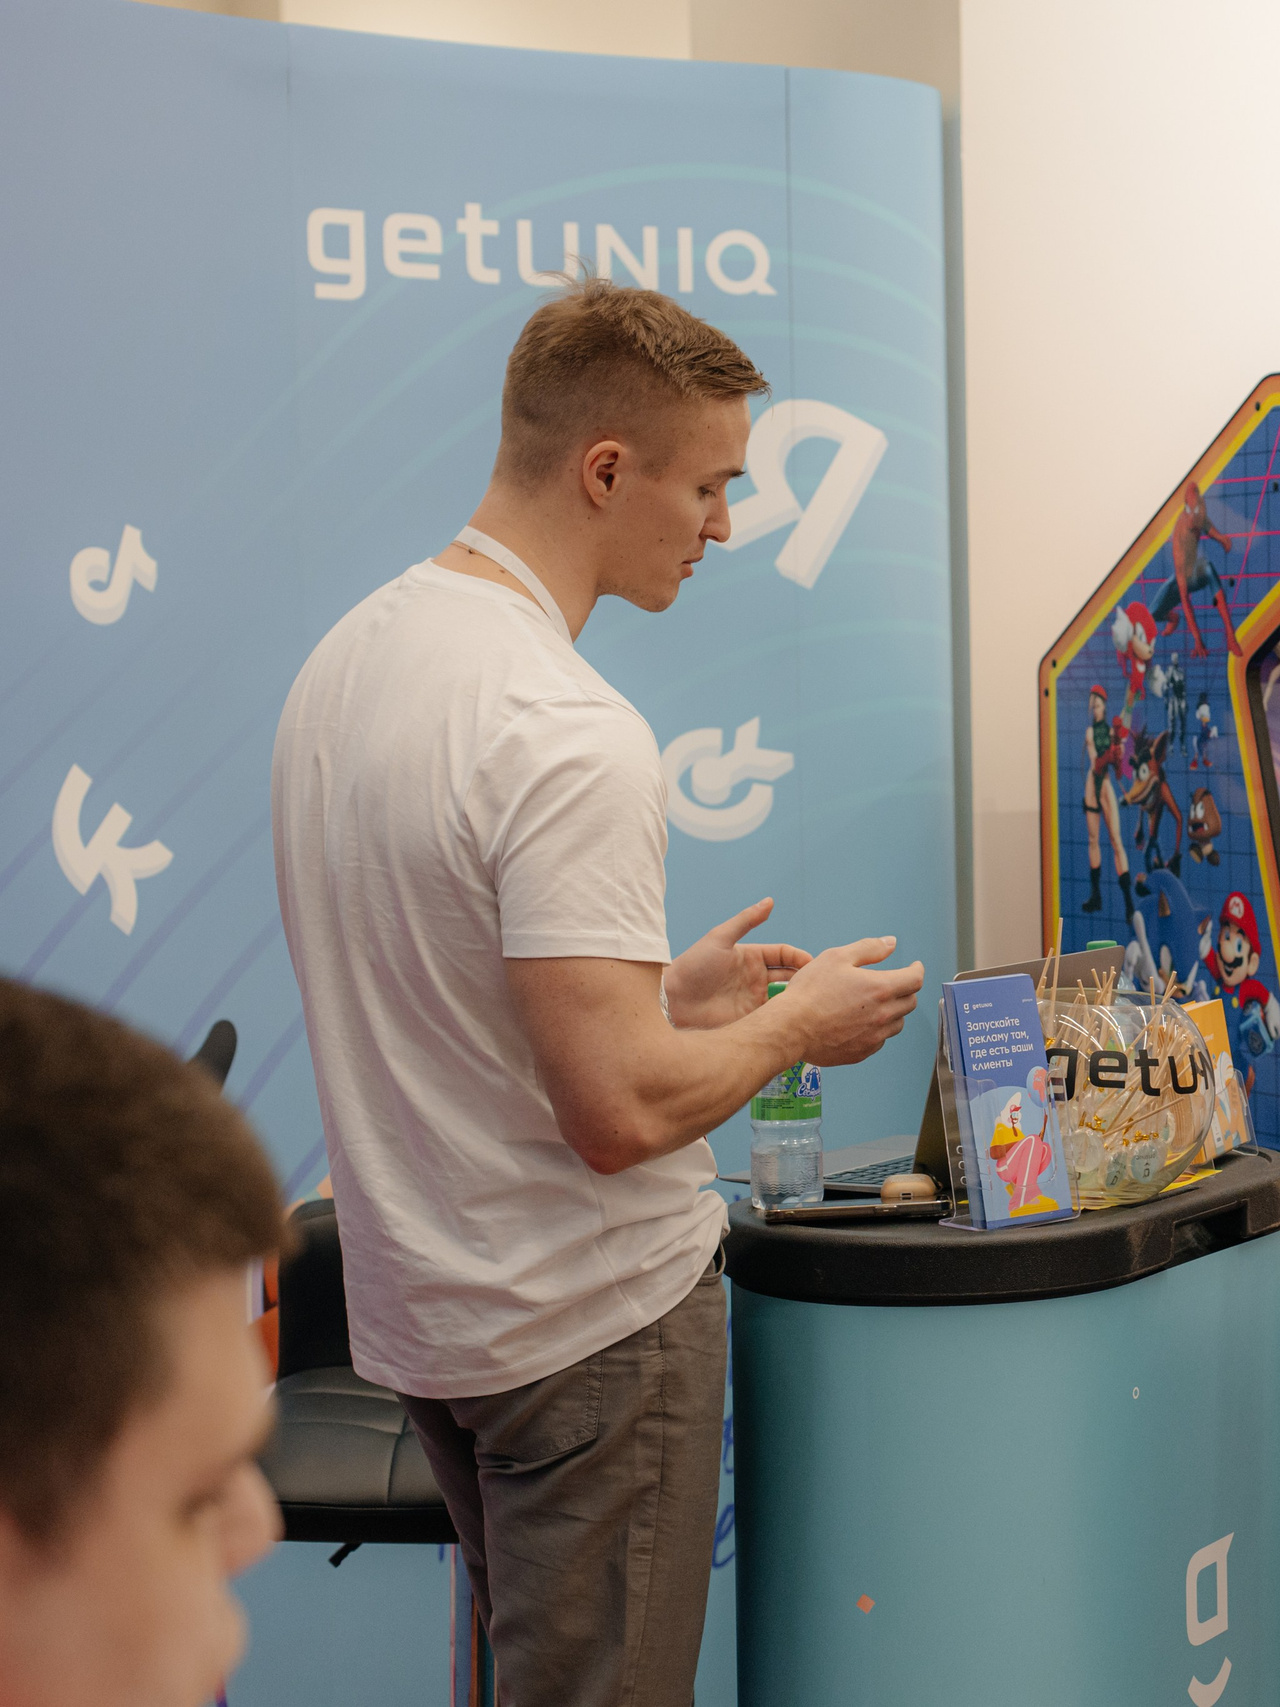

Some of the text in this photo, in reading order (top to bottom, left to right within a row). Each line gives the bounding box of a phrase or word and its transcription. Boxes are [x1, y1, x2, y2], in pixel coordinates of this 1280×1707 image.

[966, 1016, 1020, 1032] Запускайте
[968, 1030, 1030, 1047] рекламу там,
[970, 1043, 1034, 1059] где есть ваши
[972, 1058, 1013, 1072] клиенты
